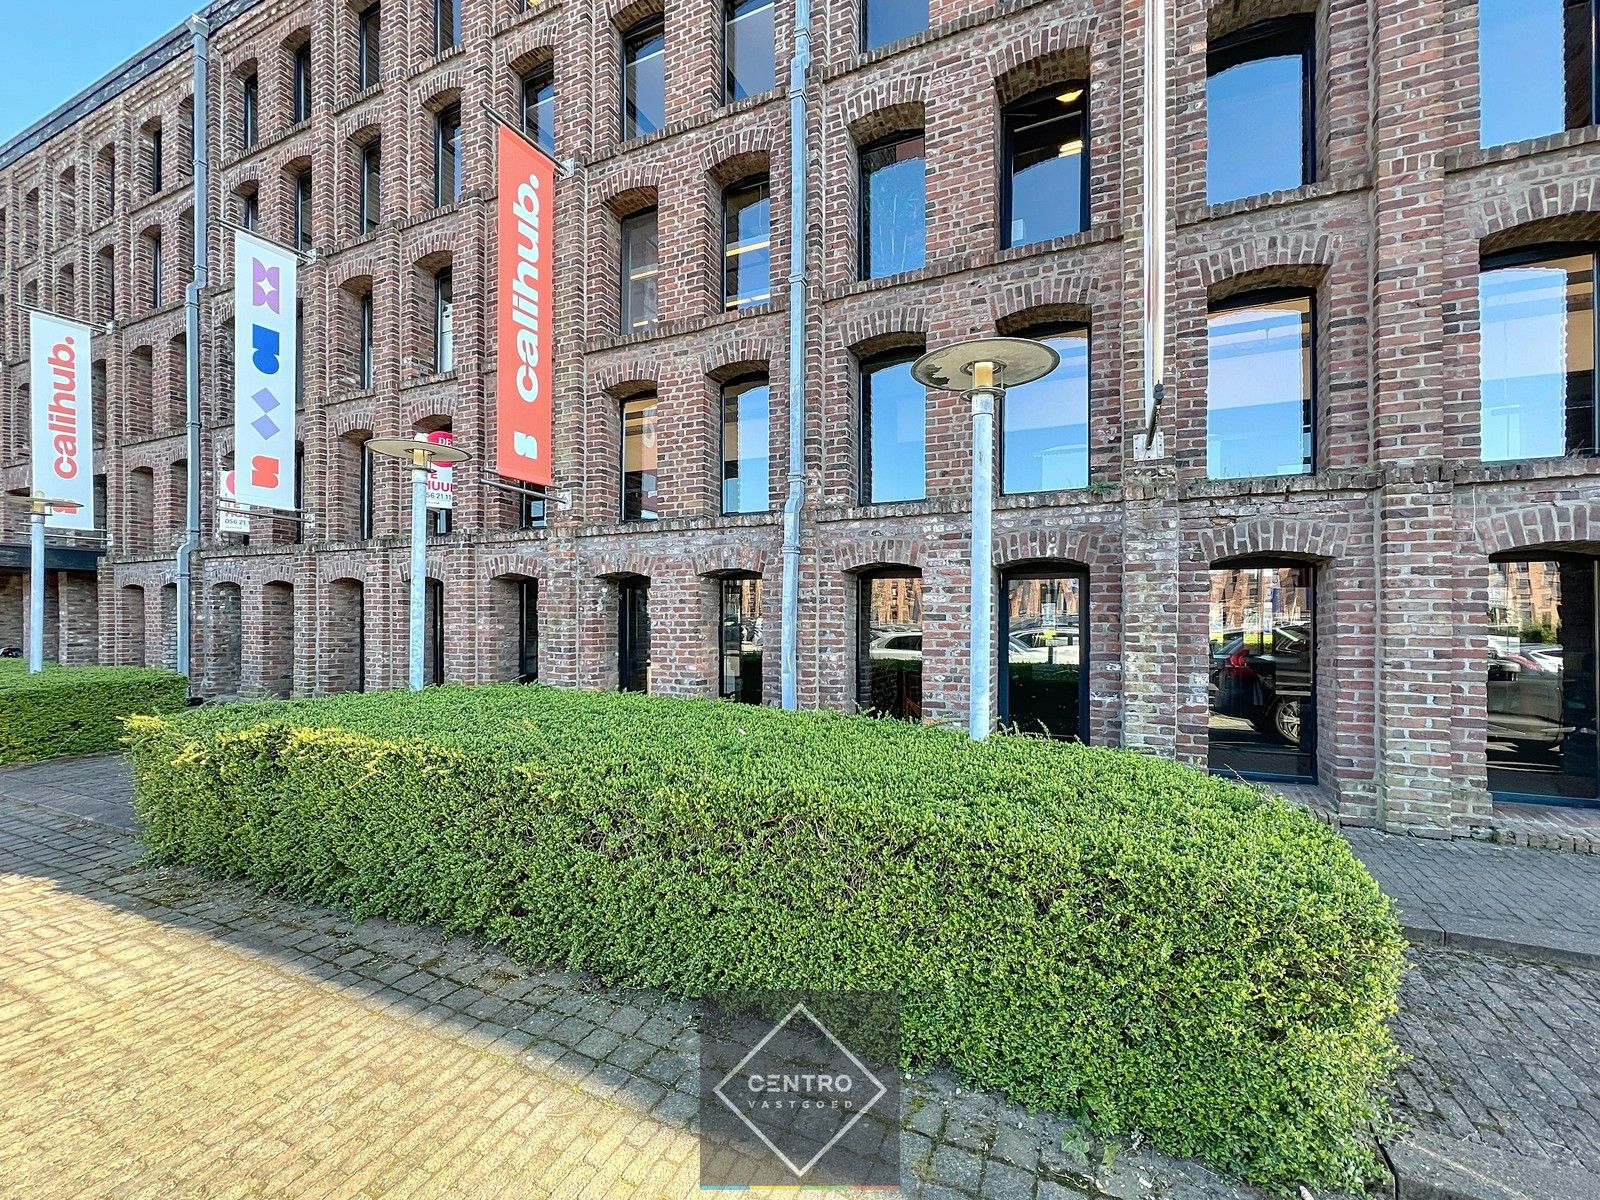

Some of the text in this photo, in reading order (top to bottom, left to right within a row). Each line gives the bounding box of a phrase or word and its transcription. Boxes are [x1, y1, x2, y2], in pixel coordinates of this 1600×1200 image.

[512, 173, 540, 403] calihub.
[47, 336, 78, 480] calihub.
[426, 481, 453, 493] HUU
